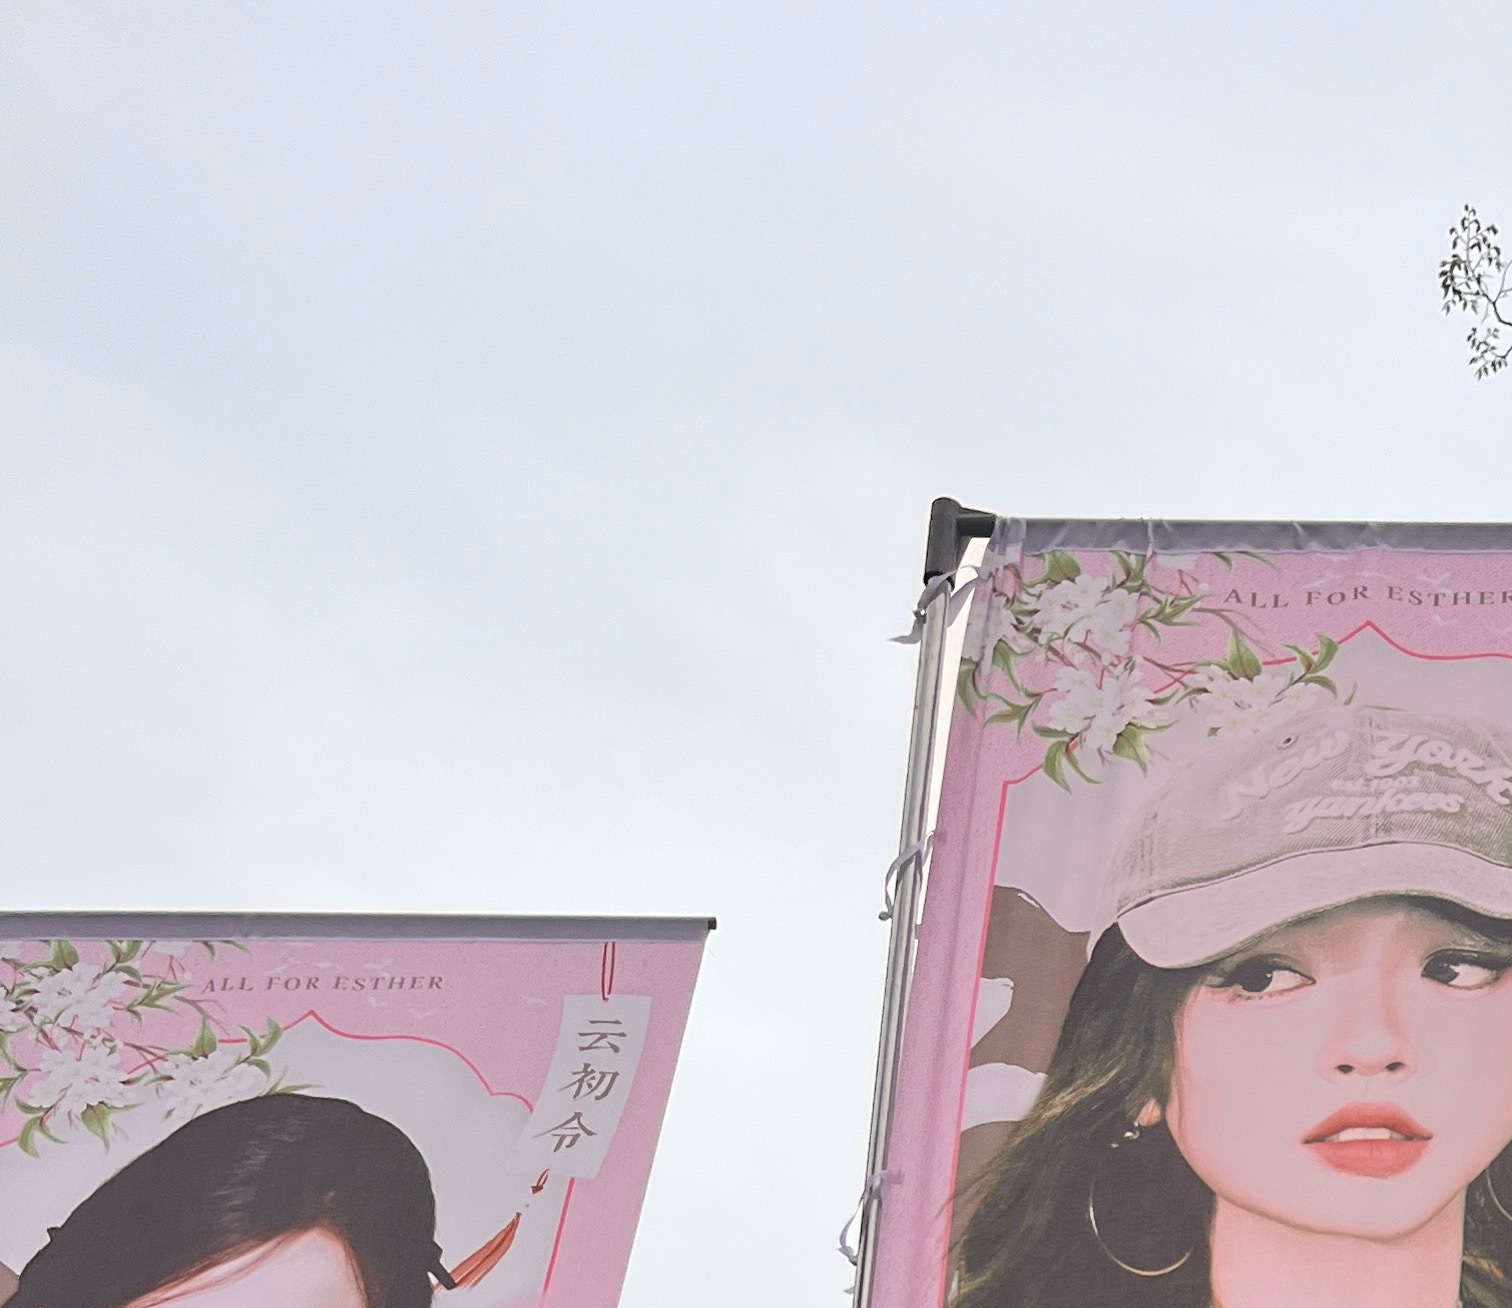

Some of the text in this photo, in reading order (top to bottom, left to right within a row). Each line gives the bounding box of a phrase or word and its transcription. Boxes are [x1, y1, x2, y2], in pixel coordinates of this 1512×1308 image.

[1223, 587, 1290, 609] ALL
[1304, 585, 1370, 607] FOR
[201, 974, 445, 995] ALL FOR ESTHER
[531, 1017, 628, 1154] 云初令
